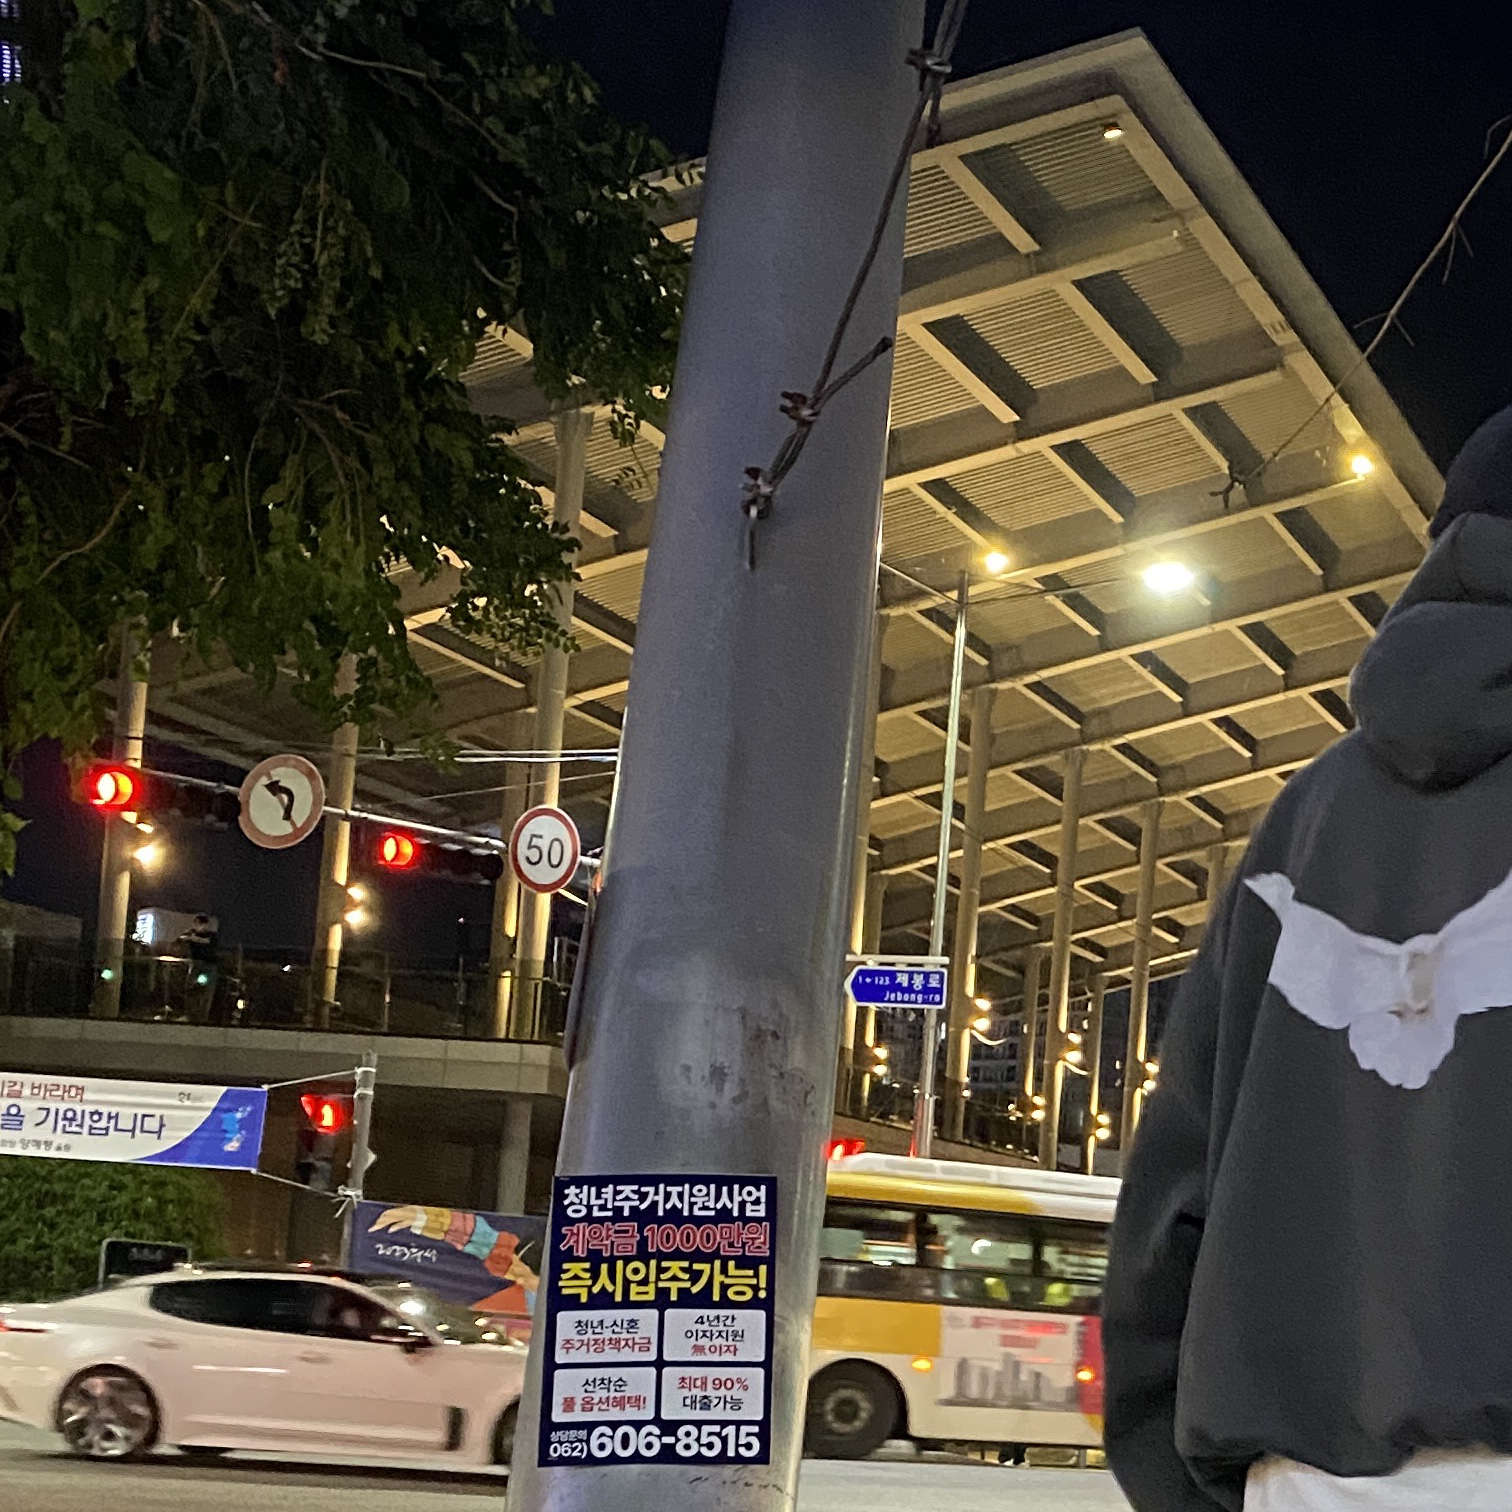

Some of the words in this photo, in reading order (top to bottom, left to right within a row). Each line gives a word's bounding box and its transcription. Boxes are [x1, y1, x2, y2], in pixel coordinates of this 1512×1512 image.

[525, 833, 564, 869] 50
[895, 972, 941, 991] 제봉로
[884, 990, 941, 1004] Jebong-ro
[31, 1081, 85, 1102] 바라며
[0, 1103, 25, 1131] 을
[35, 1107, 166, 1140] 기원합니다
[563, 1183, 767, 1217] 청년주거지원사업
[560, 1222, 640, 1257] 계약금
[645, 1221, 771, 1256] 1000만원
[558, 1260, 767, 1303] 즉시입주가능!
[694, 1313, 737, 1328] 4년간
[561, 1336, 652, 1354] 주거정책자금
[684, 1328, 745, 1343] 이자지원
[581, 1376, 629, 1393] 선착순
[677, 1375, 708, 1392] 최대
[712, 1377, 749, 1392] 90%
[580, 1394, 647, 1413] 옵션혜택!
[682, 1394, 744, 1411] 대출가능
[549, 1442, 588, 1459] 062)
[589, 1424, 761, 1458] 606-8515
[550, 1429, 588, 1442] 상담문의
